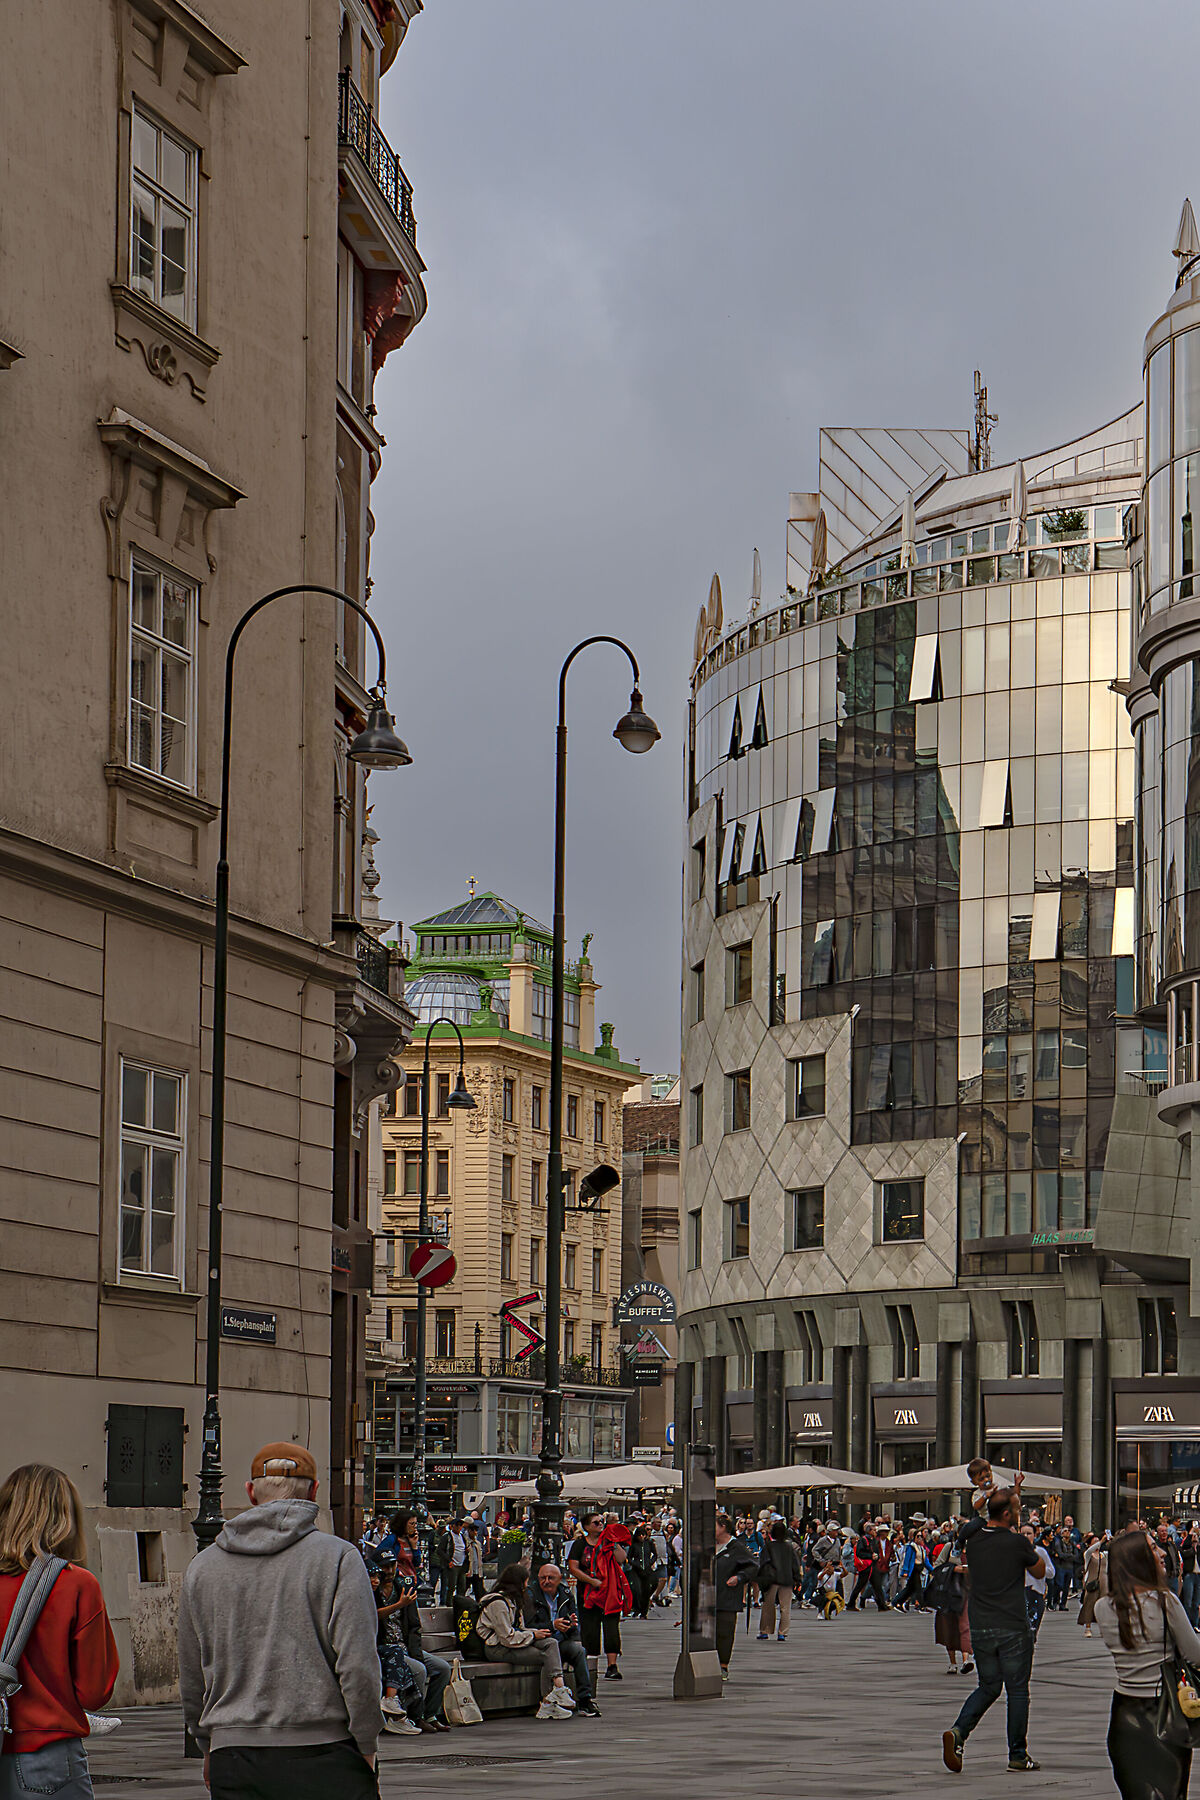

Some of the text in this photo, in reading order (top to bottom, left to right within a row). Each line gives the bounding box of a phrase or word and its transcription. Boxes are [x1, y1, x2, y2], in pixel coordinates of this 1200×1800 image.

[1032, 1232, 1060, 1244] HAAS
[628, 1307, 663, 1316] BUFFET
[804, 1412, 823, 1428] ZARA
[894, 1409, 919, 1425] ZARA
[1144, 1406, 1176, 1422] ZARA
